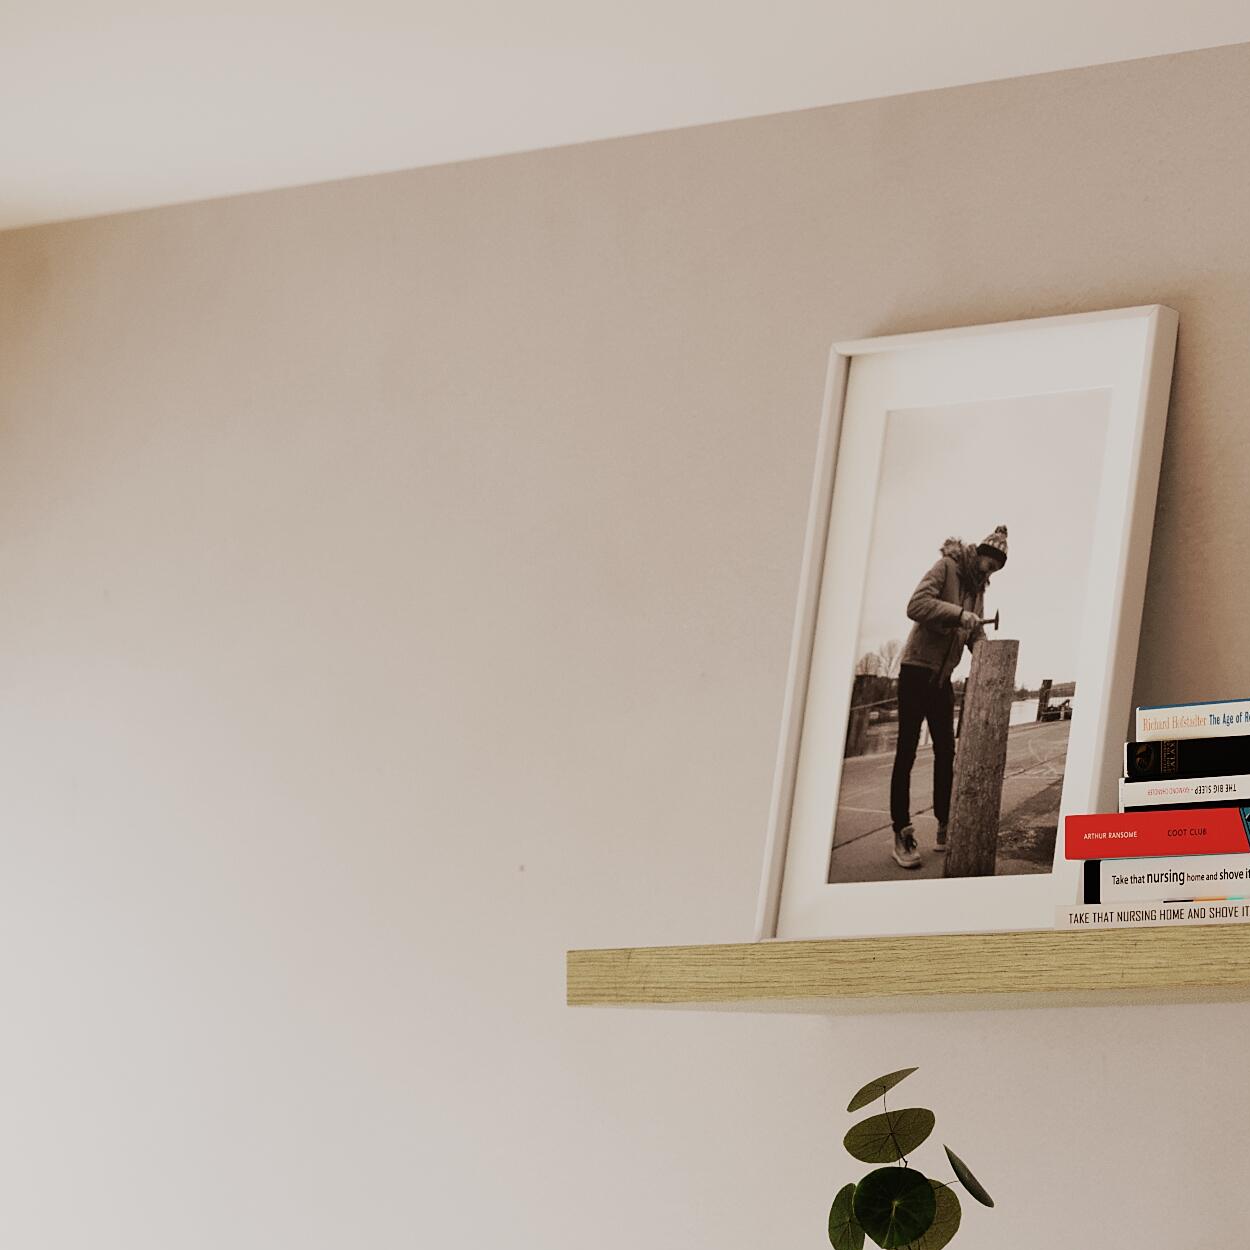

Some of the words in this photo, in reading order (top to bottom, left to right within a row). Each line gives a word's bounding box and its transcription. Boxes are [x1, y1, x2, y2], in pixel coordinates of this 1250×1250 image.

[1209, 713, 1221, 726] The
[1223, 712, 1234, 727] Age
[1235, 711, 1243, 724] of
[1194, 785, 1212, 795] SLEEP
[1213, 784, 1224, 793] BIG
[1225, 784, 1237, 793] THE
[1083, 832, 1107, 840] ARTHUR
[1108, 831, 1137, 839] RANSOME
[1167, 829, 1187, 837] COOT
[1189, 828, 1207, 836] CLUB
[1112, 875, 1129, 885] Take
[1130, 874, 1146, 885] that
[1146, 868, 1185, 886] nursing
[1186, 873, 1205, 882] home
[1205, 872, 1218, 881] and
[1219, 868, 1244, 880] shove
[1069, 913, 1090, 924] TAKE
[1092, 911, 1115, 923] THAT
[1116, 910, 1157, 922] NURSING
[1159, 908, 1185, 921] HOME
[1187, 907, 1206, 920] AND
[1209, 906, 1239, 919] SHOVE
